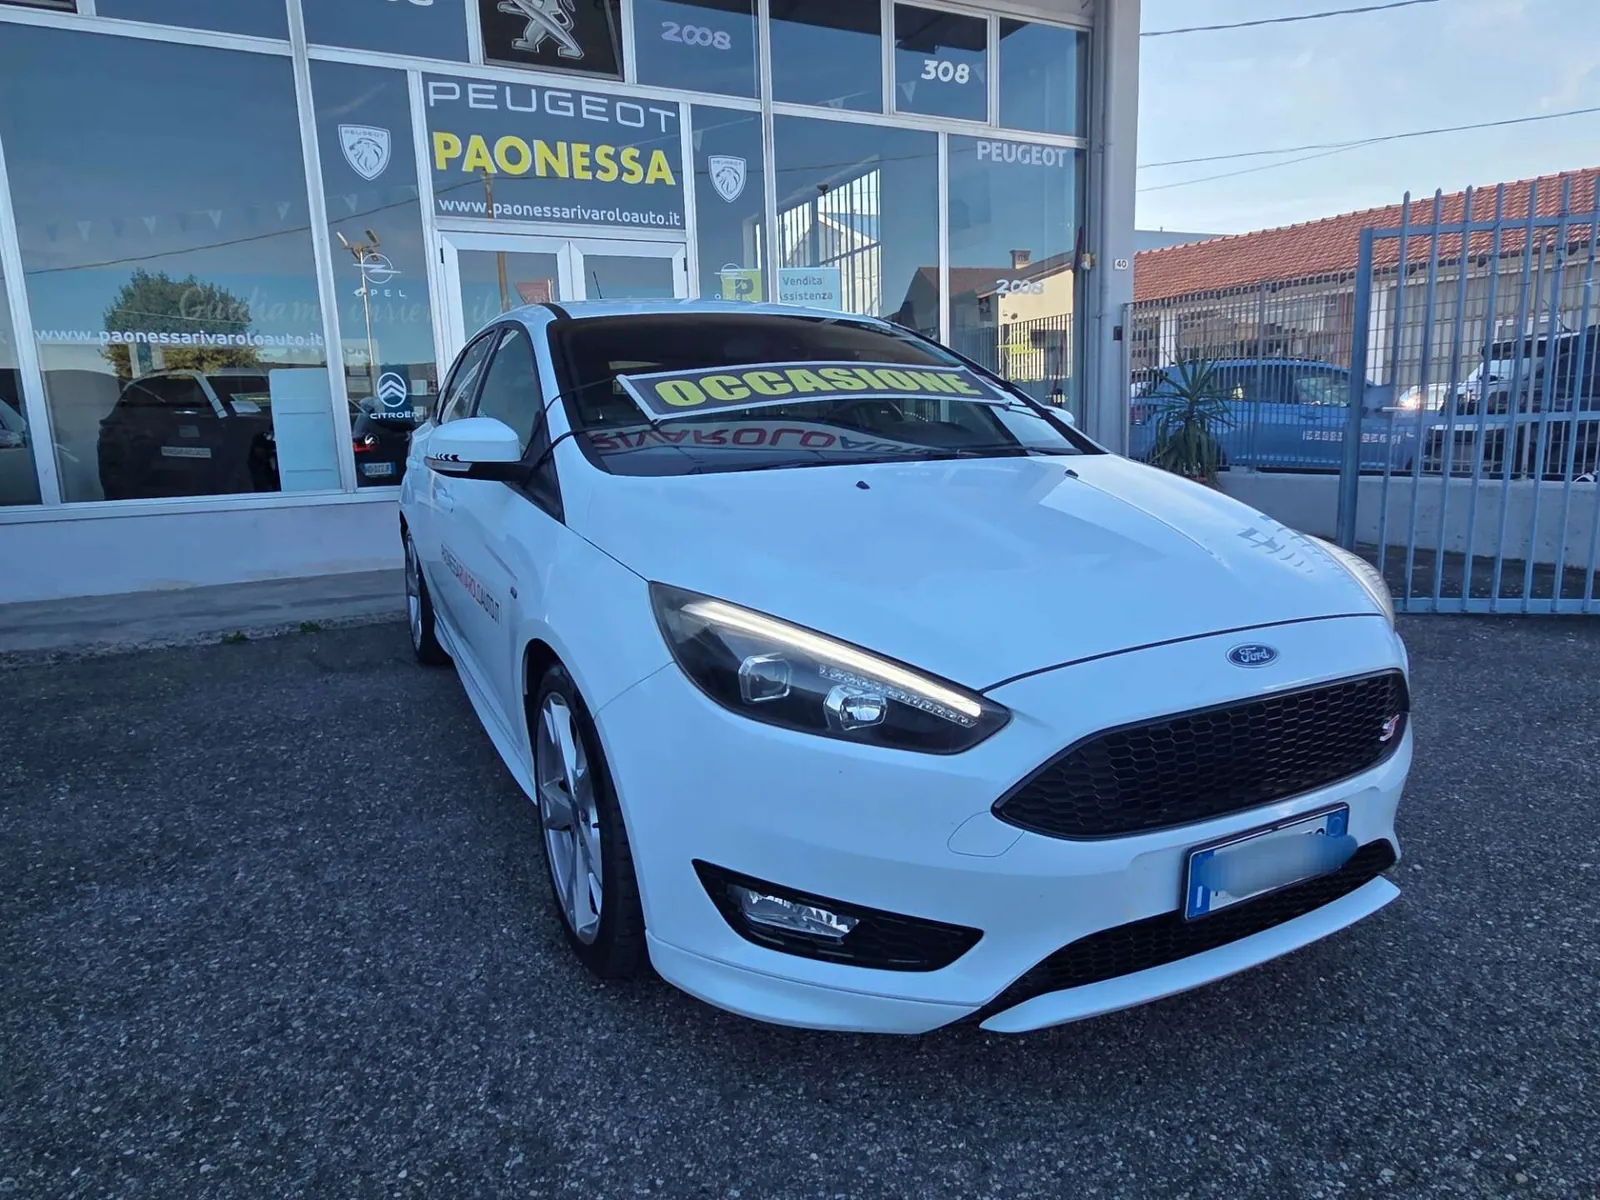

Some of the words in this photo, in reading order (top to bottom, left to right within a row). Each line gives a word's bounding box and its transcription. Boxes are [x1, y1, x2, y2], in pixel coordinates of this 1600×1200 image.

[661, 20, 732, 51] 2008
[921, 59, 971, 85] 308
[427, 81, 676, 133] PEUGEOT
[432, 131, 677, 186] PAONESSA
[976, 140, 1068, 168] PEUGEOT
[438, 198, 681, 227] www.paonessarivaroloauto.it
[1116, 259, 1128, 269] 40
[782, 276, 823, 286] Vendita
[33, 329, 325, 348] www.paonessarivaroloauto.it
[653, 367, 983, 408] OCCASIONE
[1239, 646, 1270, 663] Ford
